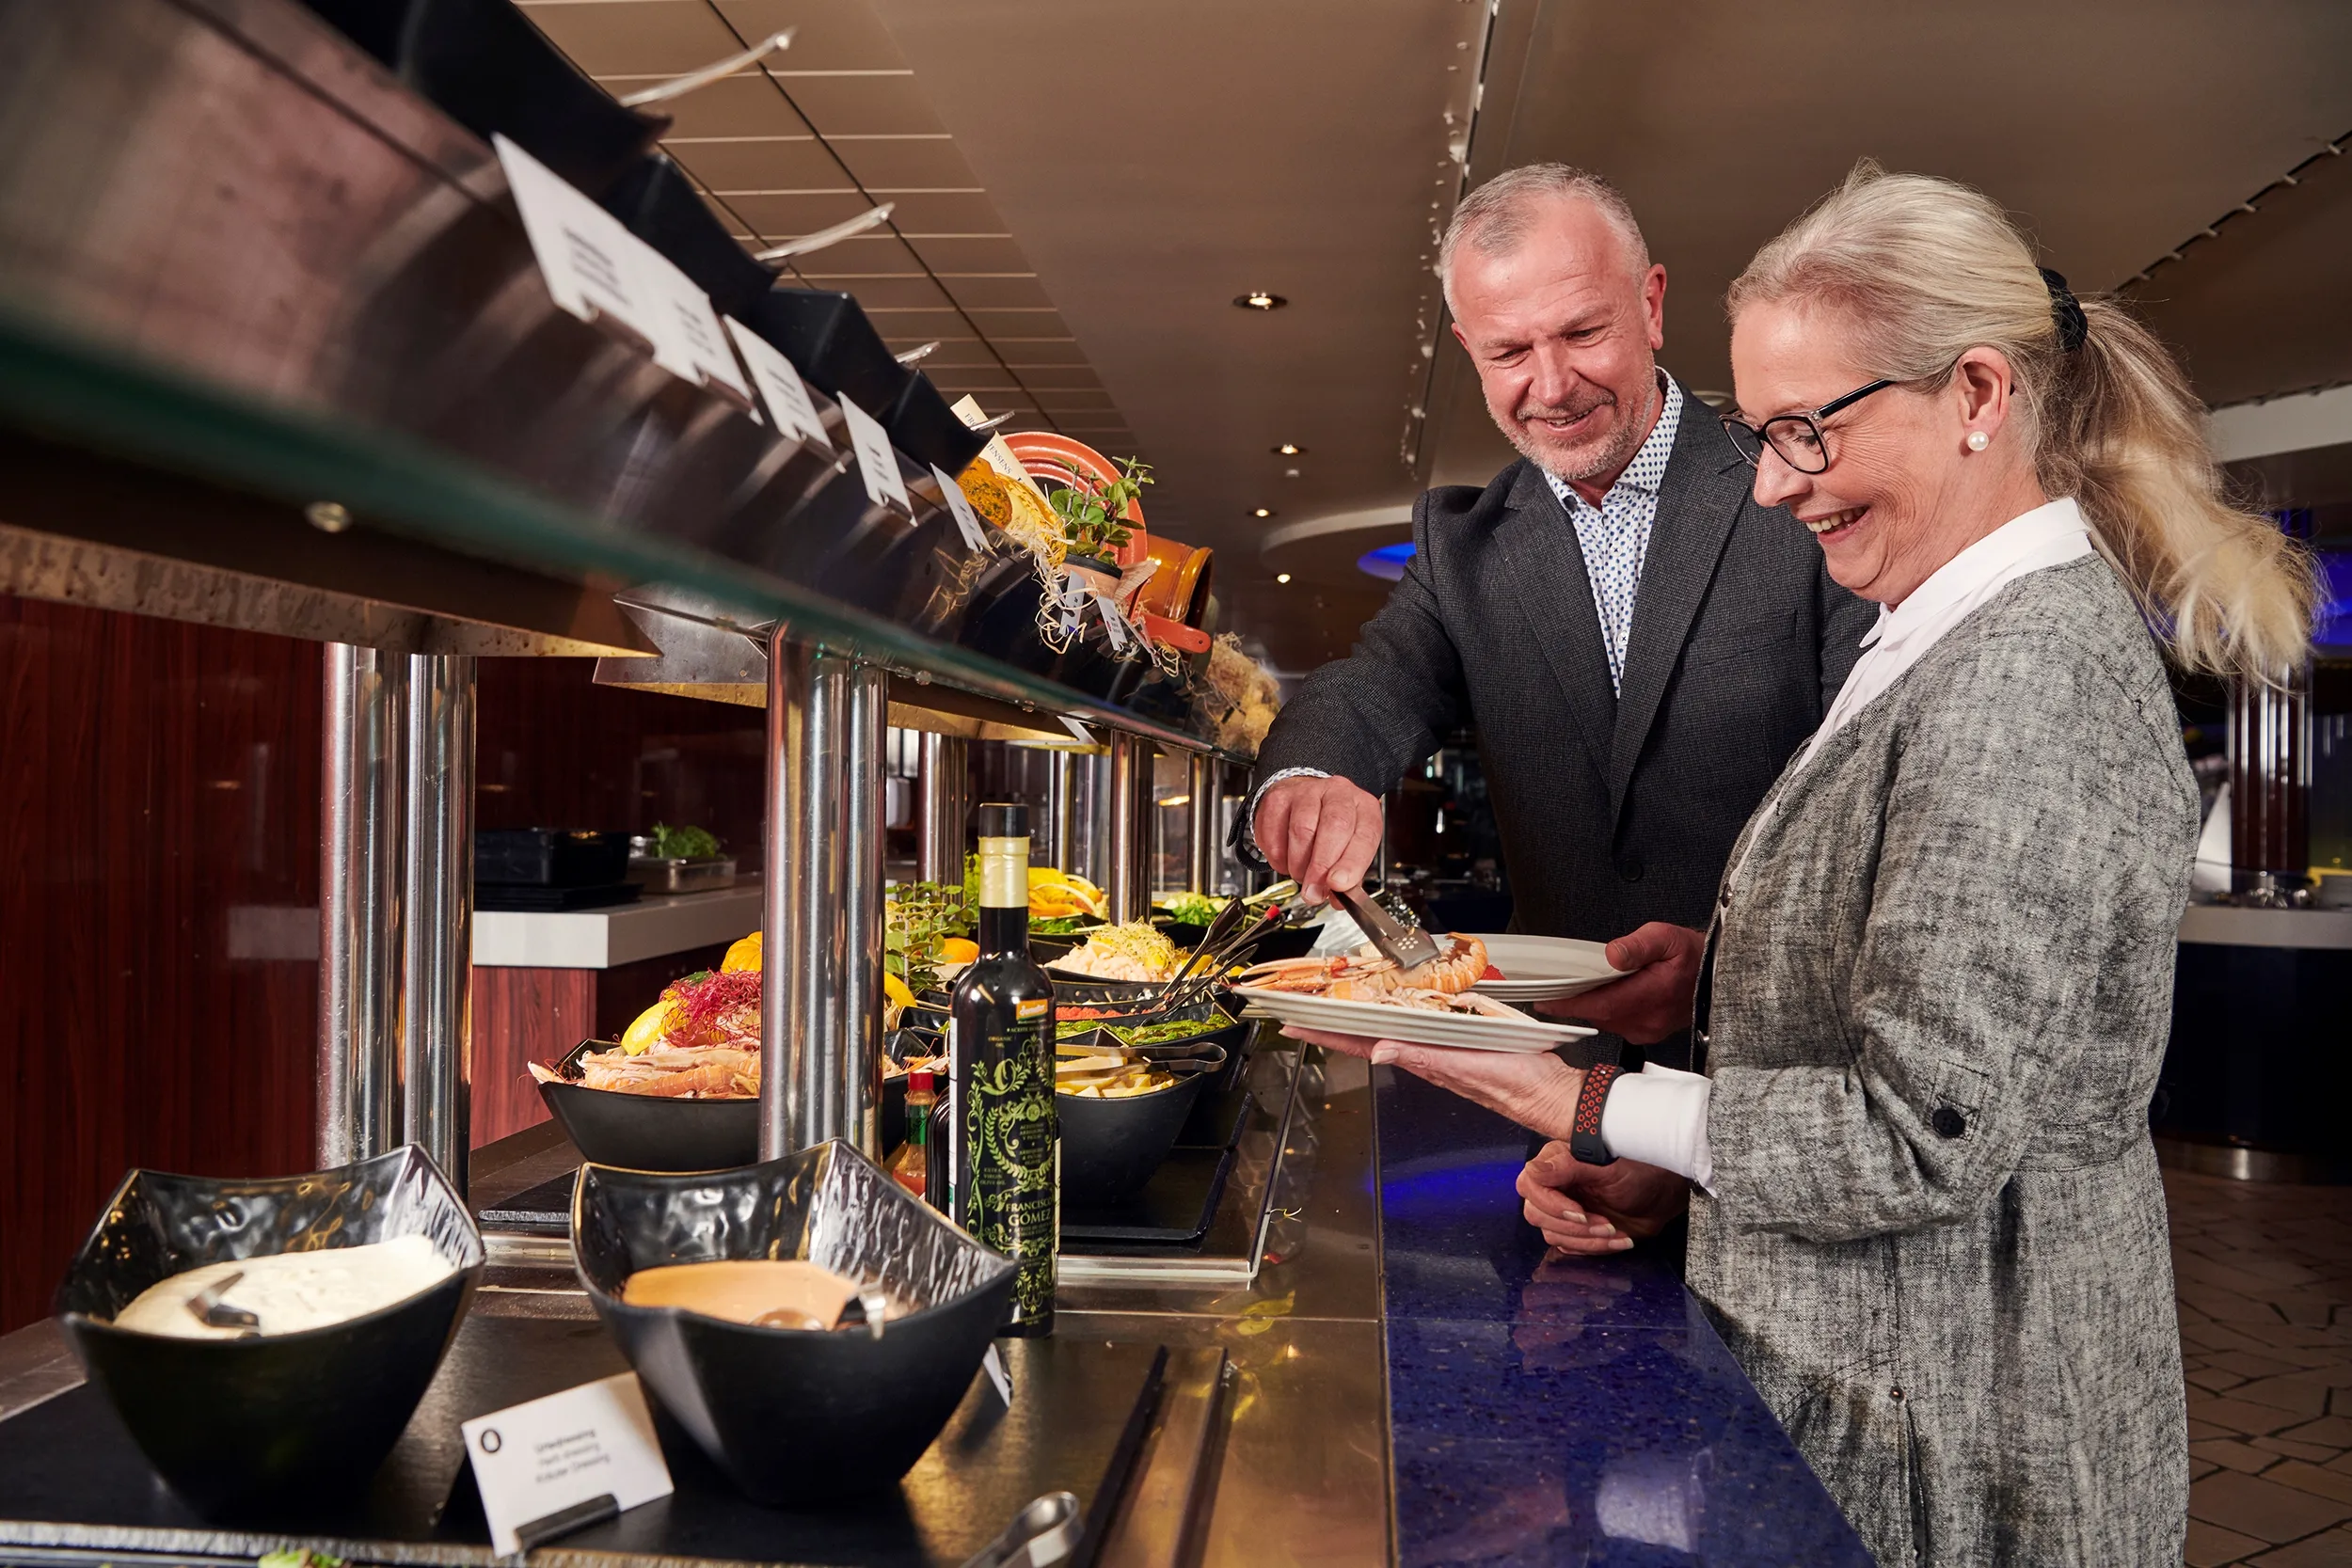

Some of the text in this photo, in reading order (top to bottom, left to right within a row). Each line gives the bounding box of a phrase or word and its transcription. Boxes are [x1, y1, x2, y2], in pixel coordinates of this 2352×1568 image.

[987, 443, 1012, 474] JENSENS
[1005, 1197, 1053, 1212] FRANCISCO
[1008, 1208, 1051, 1227] GÓMEZ
